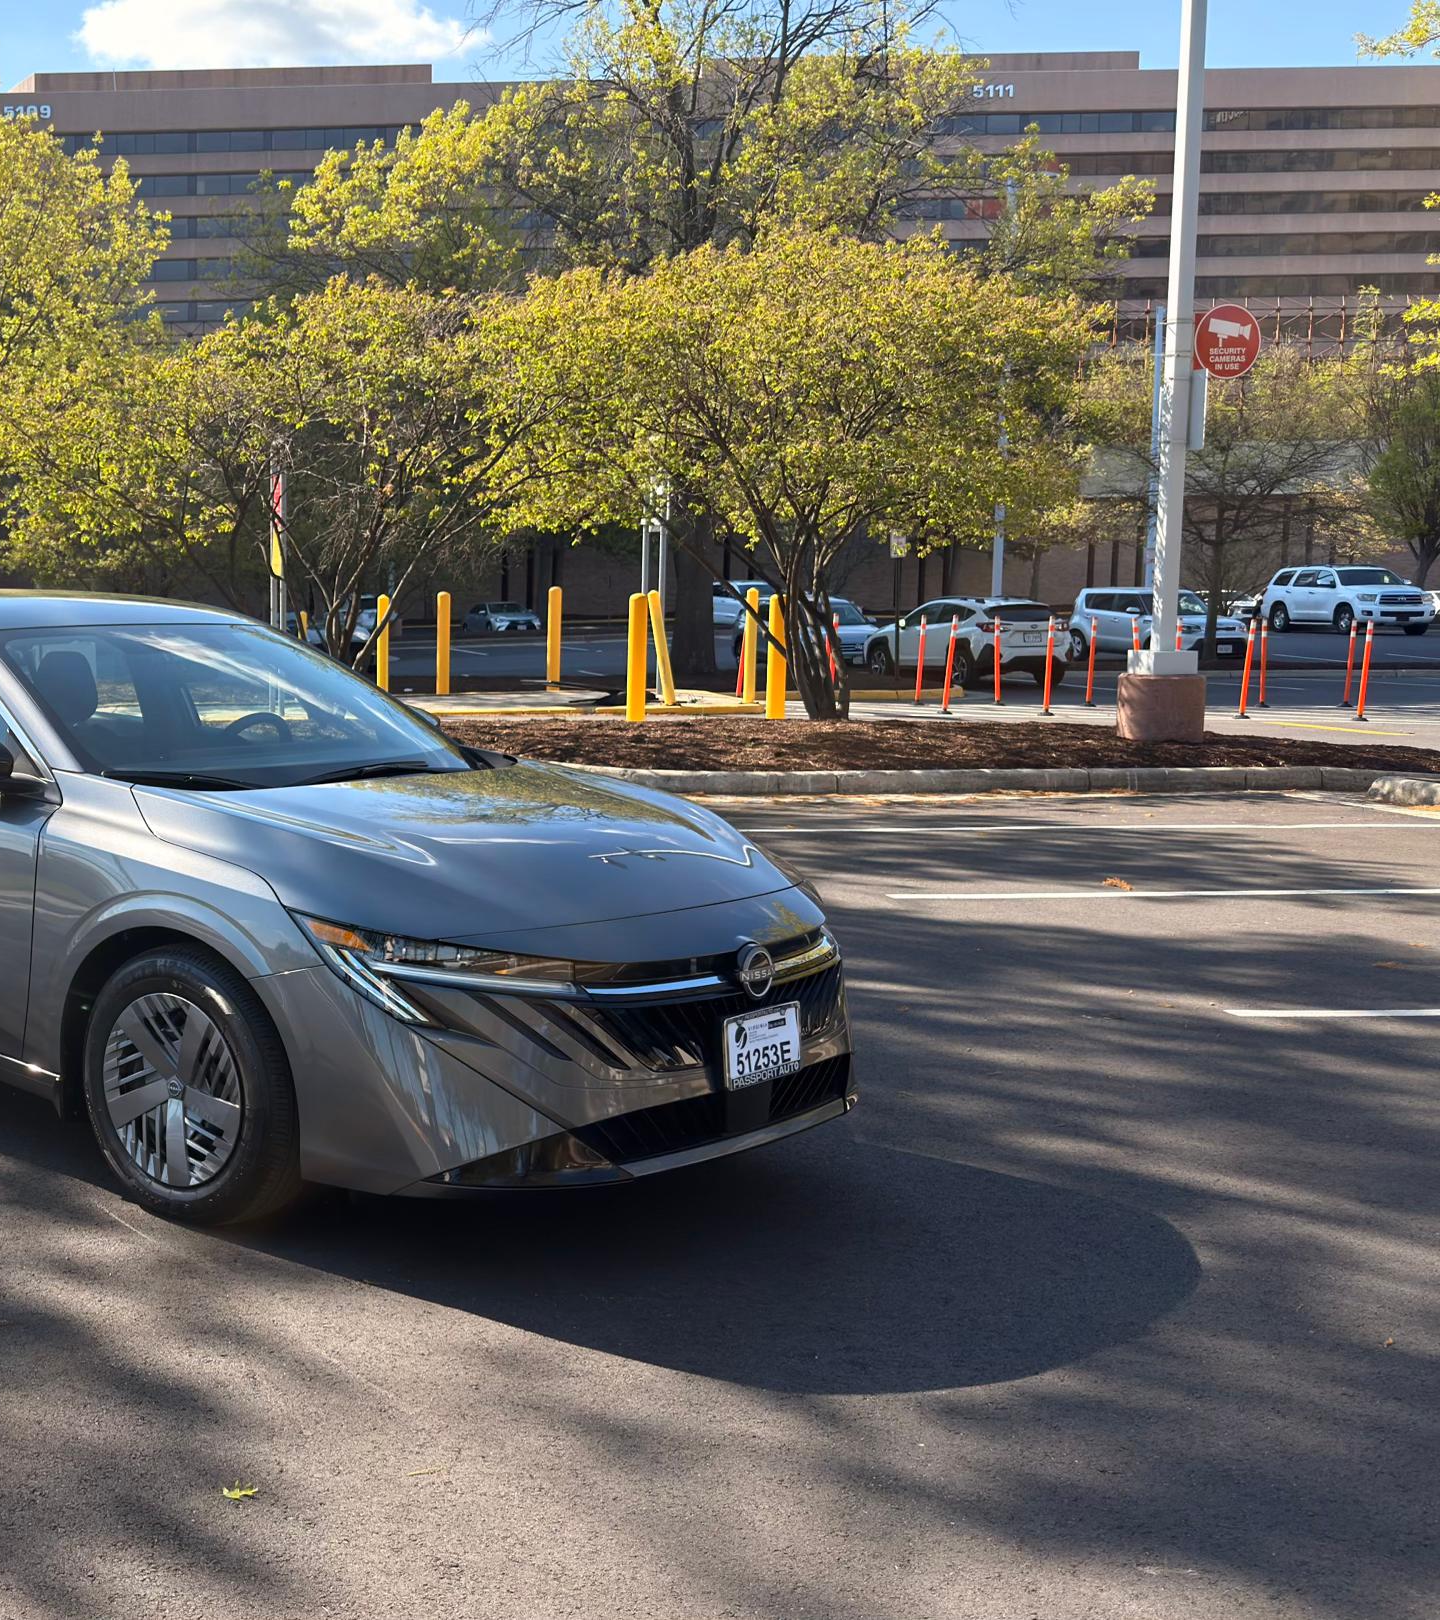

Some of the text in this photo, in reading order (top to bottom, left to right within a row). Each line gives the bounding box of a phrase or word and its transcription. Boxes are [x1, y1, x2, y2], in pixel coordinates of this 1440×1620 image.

[972, 84, 1015, 98] 5111
[3, 105, 52, 119] 5109
[741, 967, 776, 981] NISSAN
[737, 1041, 791, 1075] 51253E
[733, 1061, 799, 1089] PASSPORT AUTO
